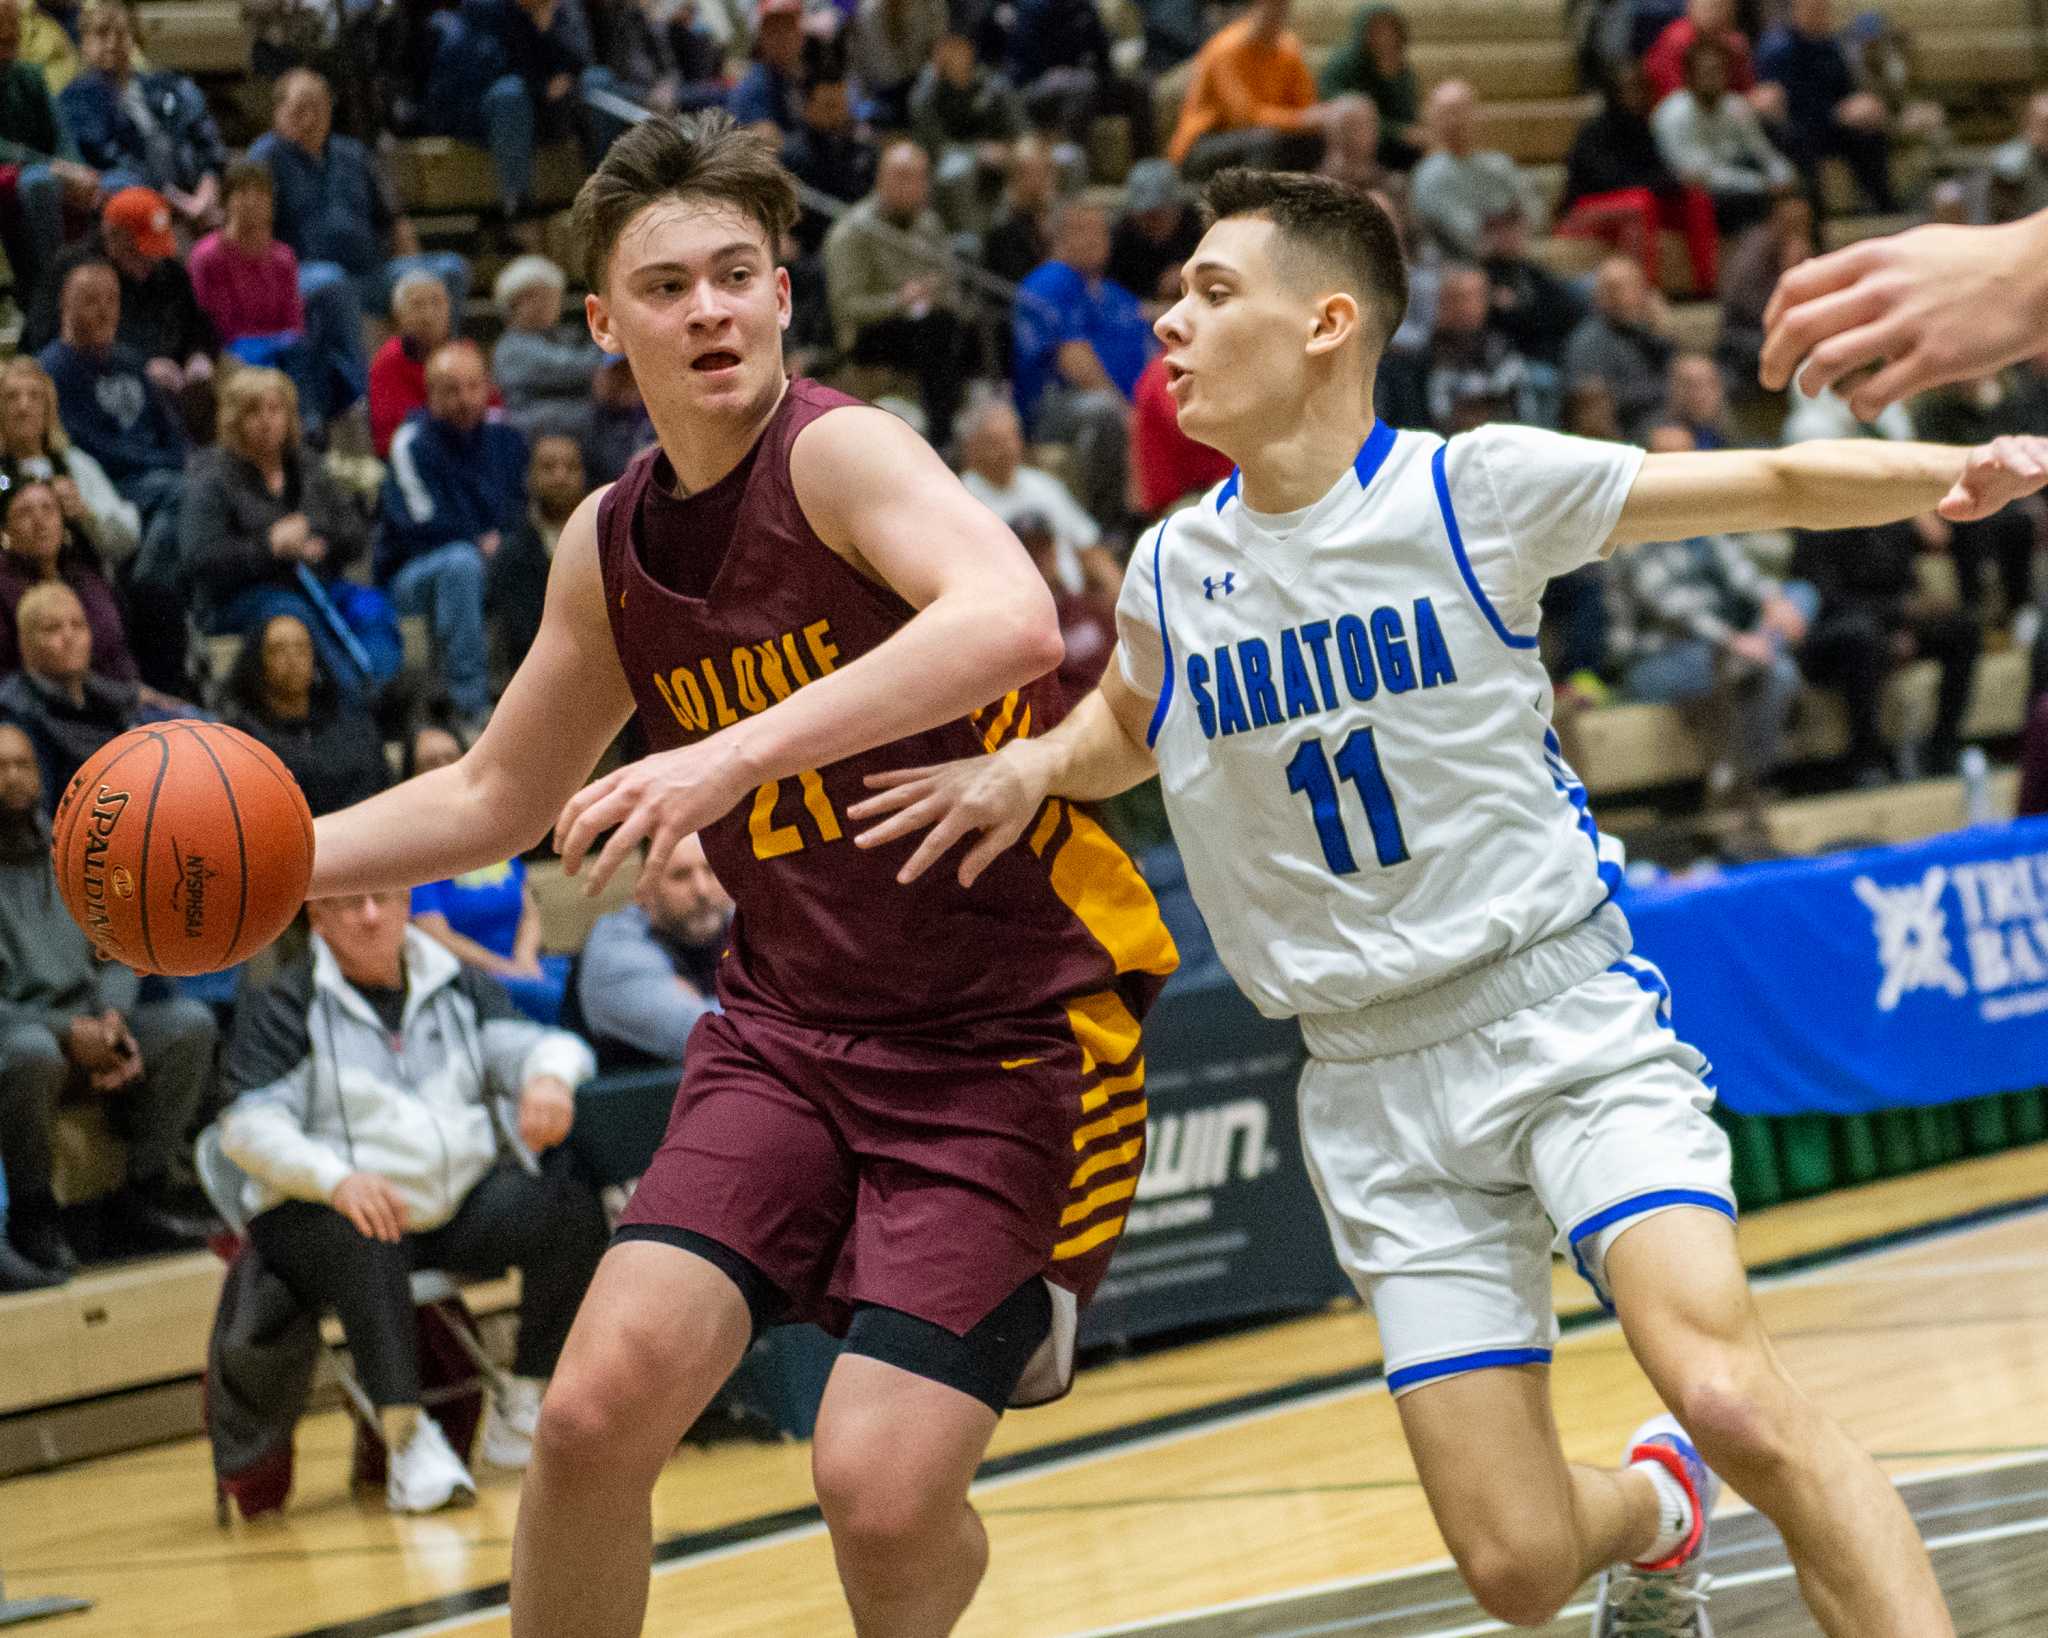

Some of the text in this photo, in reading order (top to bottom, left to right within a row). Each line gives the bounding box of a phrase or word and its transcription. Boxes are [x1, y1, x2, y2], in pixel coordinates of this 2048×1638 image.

[654, 619, 839, 731] COLONIE
[1187, 597, 1457, 740] SARATOGA
[749, 769, 843, 861] 21
[1285, 726, 1412, 875] 11
[83, 784, 132, 959] SPALDING
[184, 854, 205, 939] NYSPHSAA
